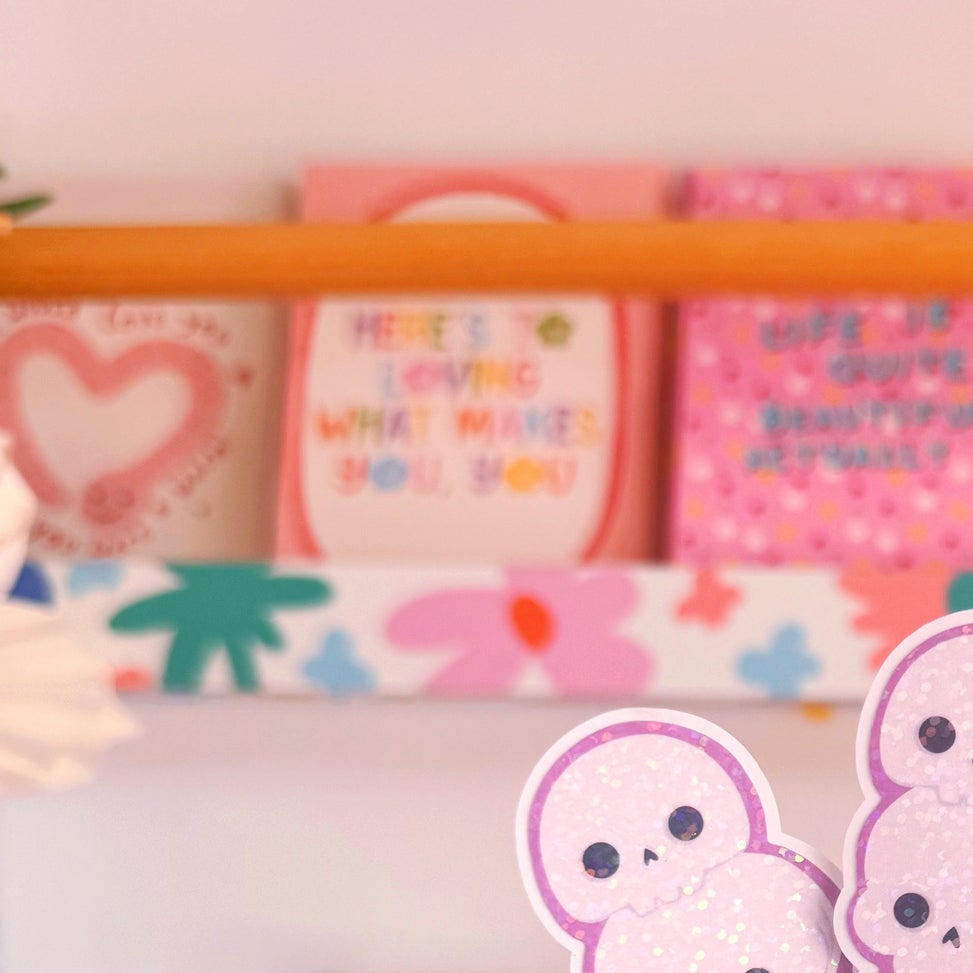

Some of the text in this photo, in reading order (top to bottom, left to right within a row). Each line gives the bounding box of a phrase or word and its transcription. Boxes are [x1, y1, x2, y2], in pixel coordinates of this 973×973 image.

[353, 312, 574, 351] HERE'S TO
[380, 359, 543, 400] LOVING
[825, 346, 968, 385] QUITE
[316, 407, 600, 449] WHAT MAKES
[471, 456, 579, 498] YOU
